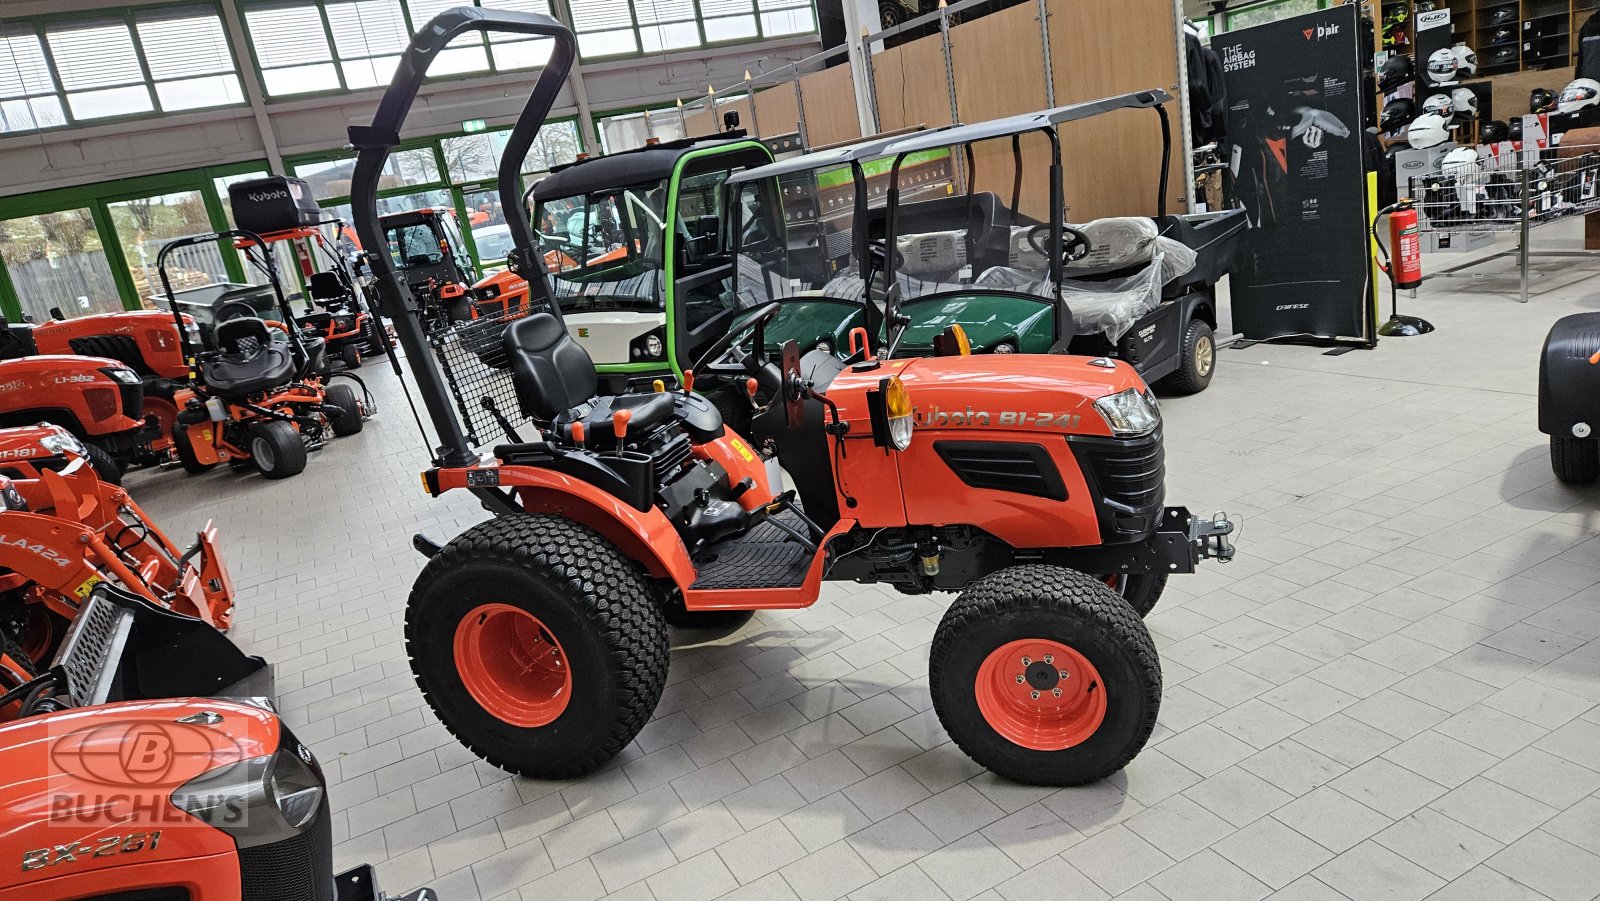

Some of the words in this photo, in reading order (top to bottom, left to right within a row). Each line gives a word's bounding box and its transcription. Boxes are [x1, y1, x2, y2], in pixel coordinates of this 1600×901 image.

[1222, 43, 1243, 57] THE
[1223, 50, 1256, 65] AIRBAG
[1223, 58, 1256, 73] SYSTEM
[248, 188, 289, 203] Kubota
[999, 411, 1081, 428] B1-241
[1, 535, 71, 568] LA424
[21, 830, 162, 872] BX-261
